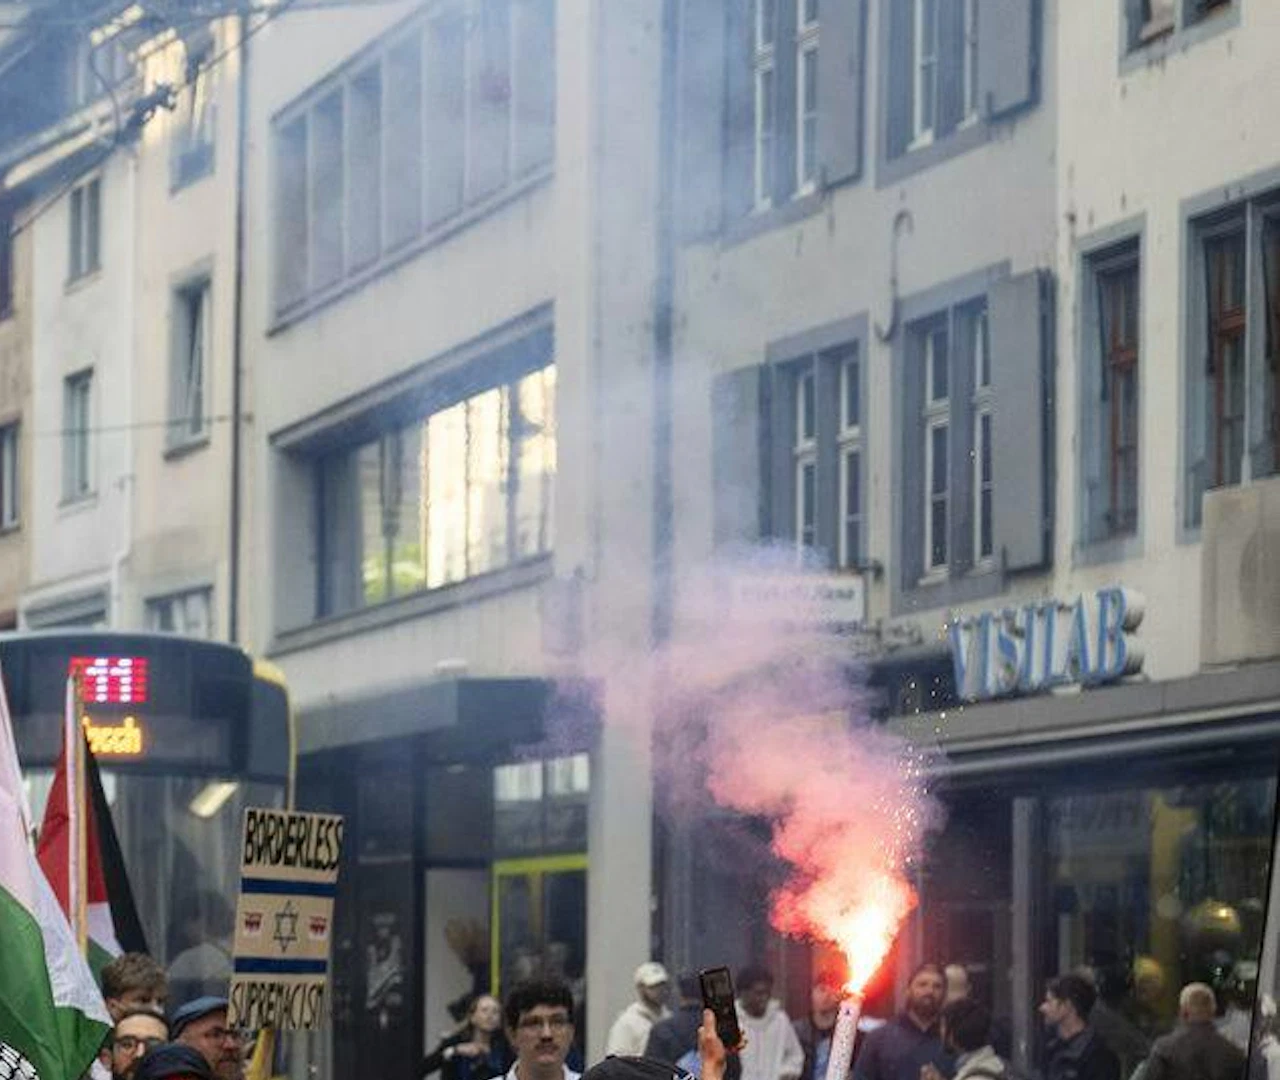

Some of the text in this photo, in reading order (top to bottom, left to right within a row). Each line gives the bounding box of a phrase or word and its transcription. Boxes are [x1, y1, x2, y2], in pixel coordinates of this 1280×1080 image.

[952, 584, 1147, 701] VISILAB
[85, 657, 133, 702] 11
[243, 810, 345, 870] BORDERLESS
[227, 981, 325, 1030] SUPREMACISM
